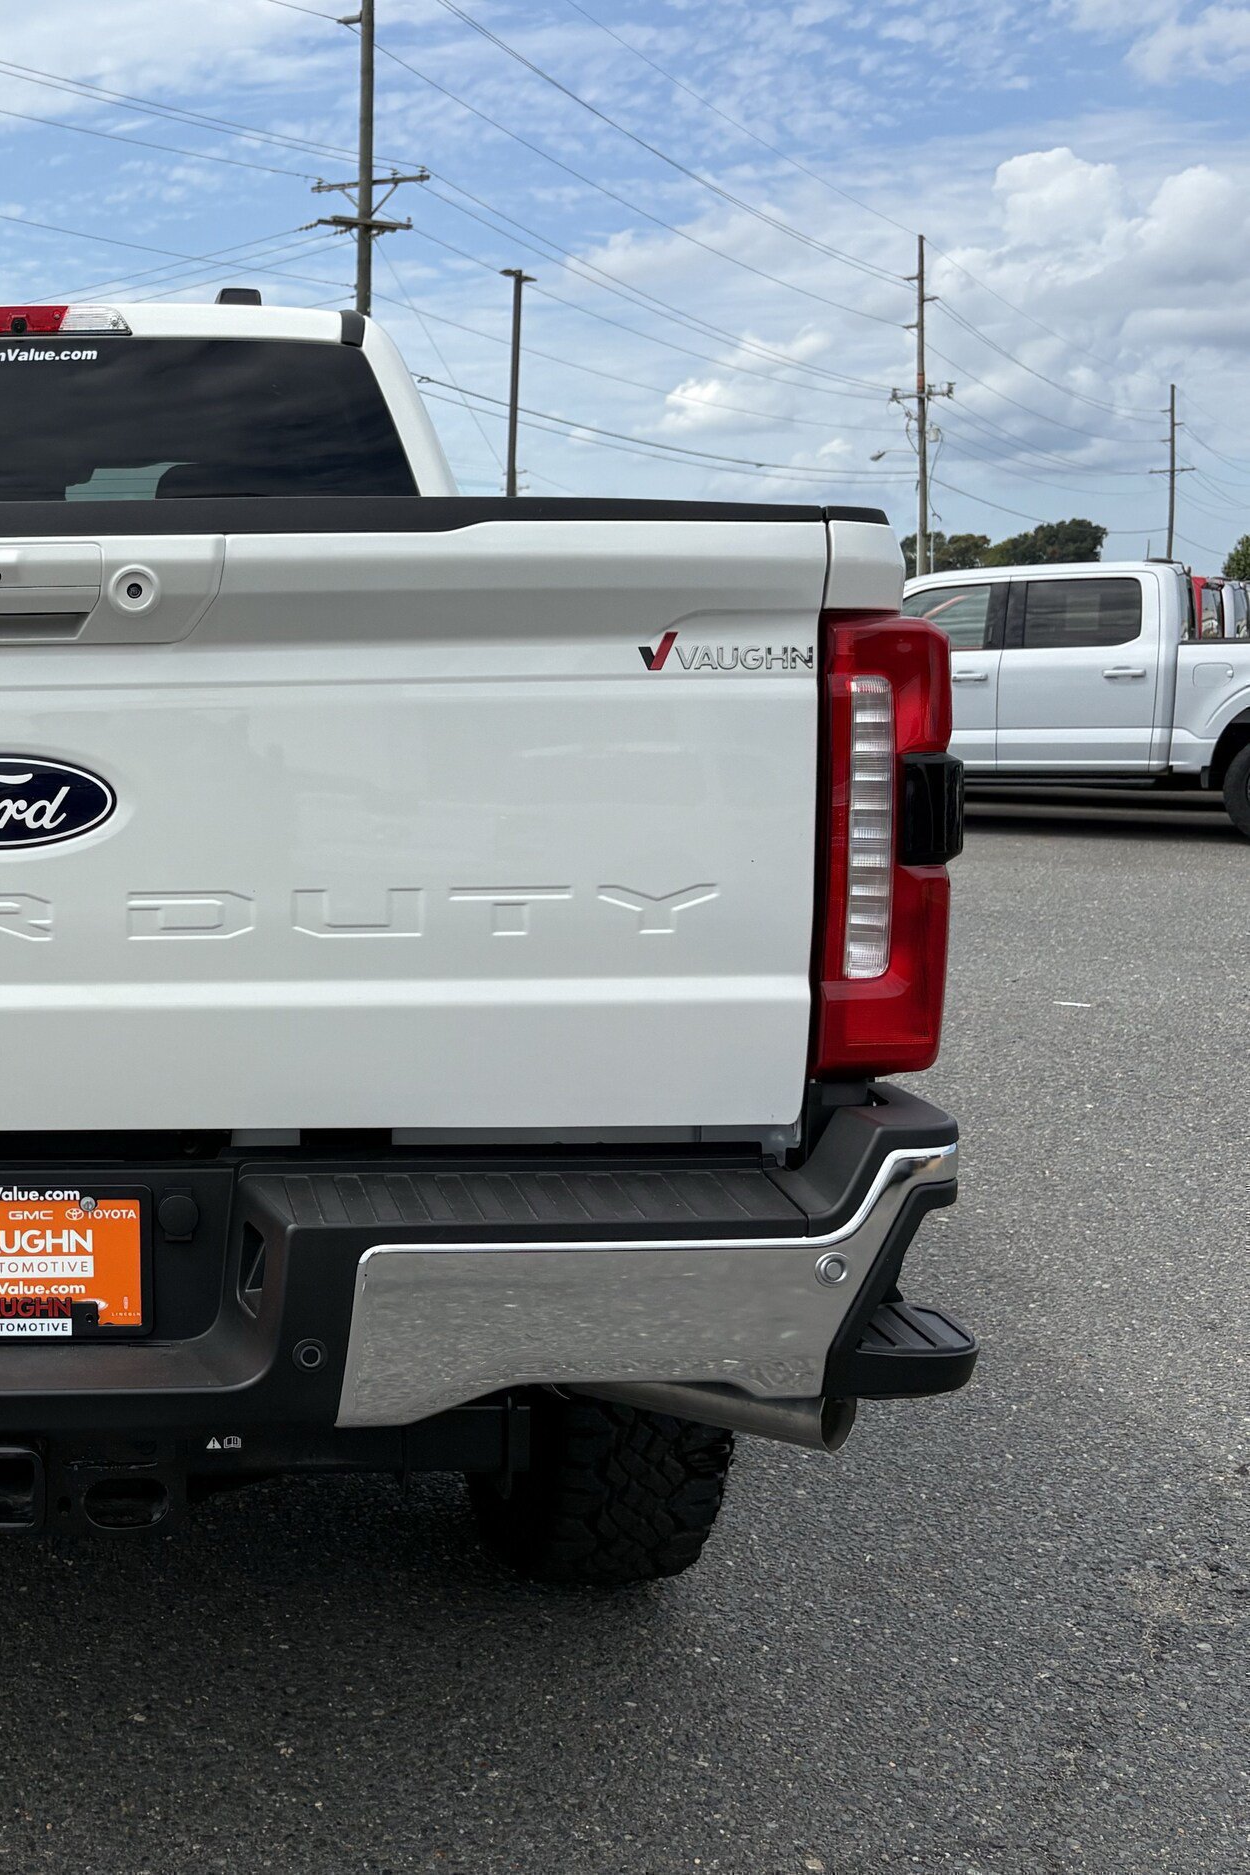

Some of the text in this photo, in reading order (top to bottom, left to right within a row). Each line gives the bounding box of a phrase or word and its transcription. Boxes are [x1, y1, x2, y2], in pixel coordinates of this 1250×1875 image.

[674, 645, 814, 671] VAUGHN
[126, 883, 720, 941] DUTY
[8, 1210, 54, 1220] GMC
[88, 1209, 137, 1219] TOYOTA
